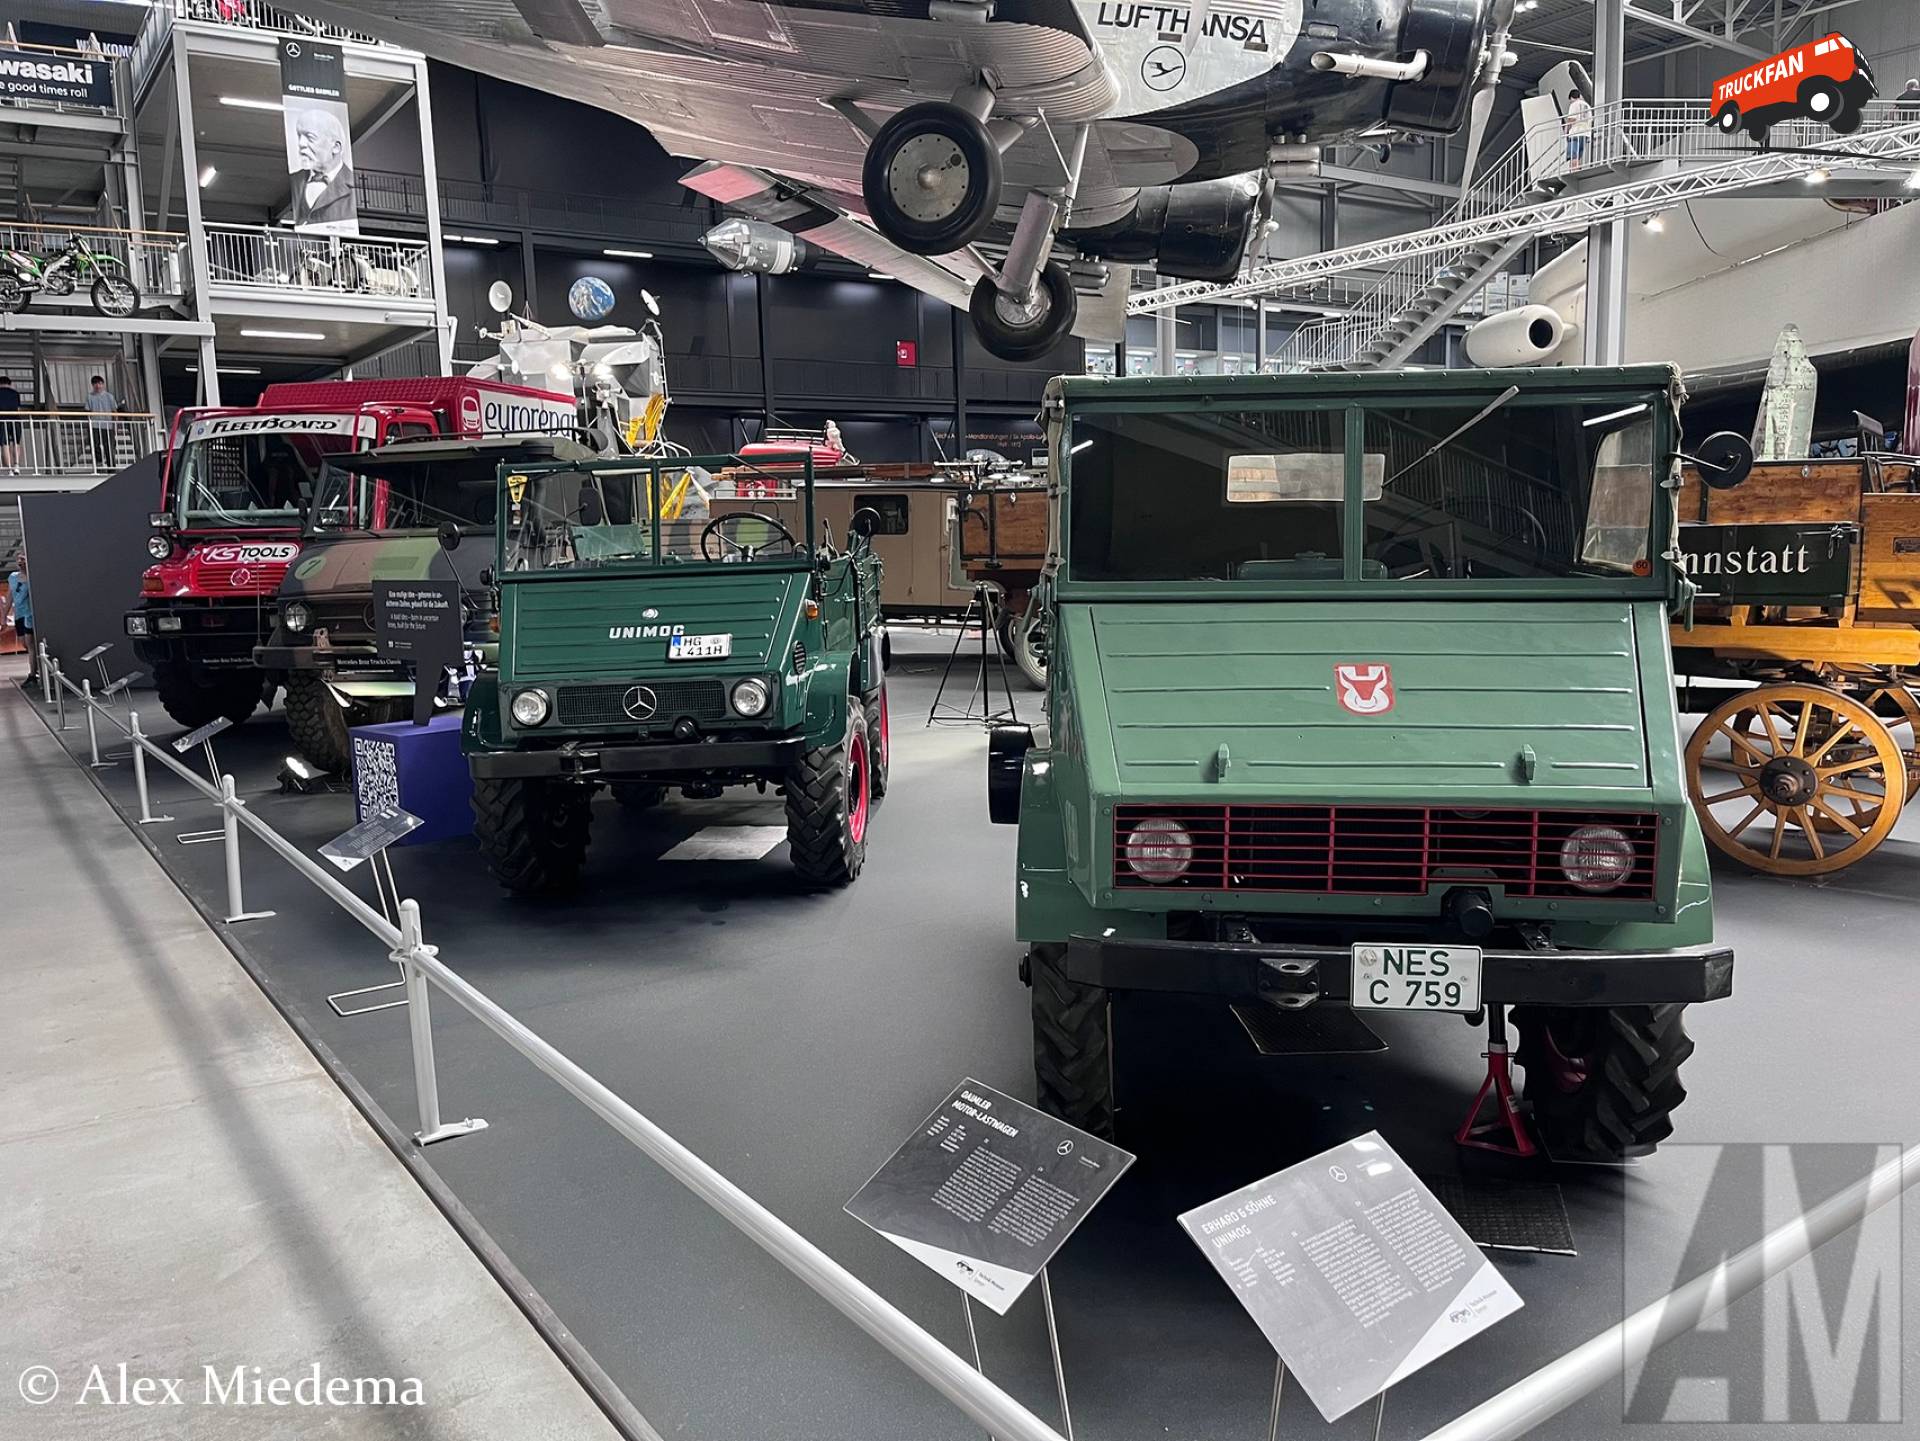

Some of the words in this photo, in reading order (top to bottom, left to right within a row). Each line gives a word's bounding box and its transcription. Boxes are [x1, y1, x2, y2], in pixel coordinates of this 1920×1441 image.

[8, 82, 37, 93] good
[39, 84, 68, 96] times
[70, 88, 88, 98] roll
[206, 547, 240, 561] KS
[241, 547, 290, 558] TOOLS
[684, 637, 702, 646] HG
[687, 645, 722, 656] 411H
[1383, 948, 1450, 976] NES
[1369, 979, 1389, 1004] C
[1405, 981, 1461, 1007] 759
[961, 1090, 992, 1110] DAIMLER
[951, 1100, 1019, 1138] MOTOR-LASTWAGEN
[1201, 1211, 1240, 1235] ERHARD
[1245, 1194, 1277, 1215] SÖHNE
[1211, 1224, 1252, 1248] UNIMOG
